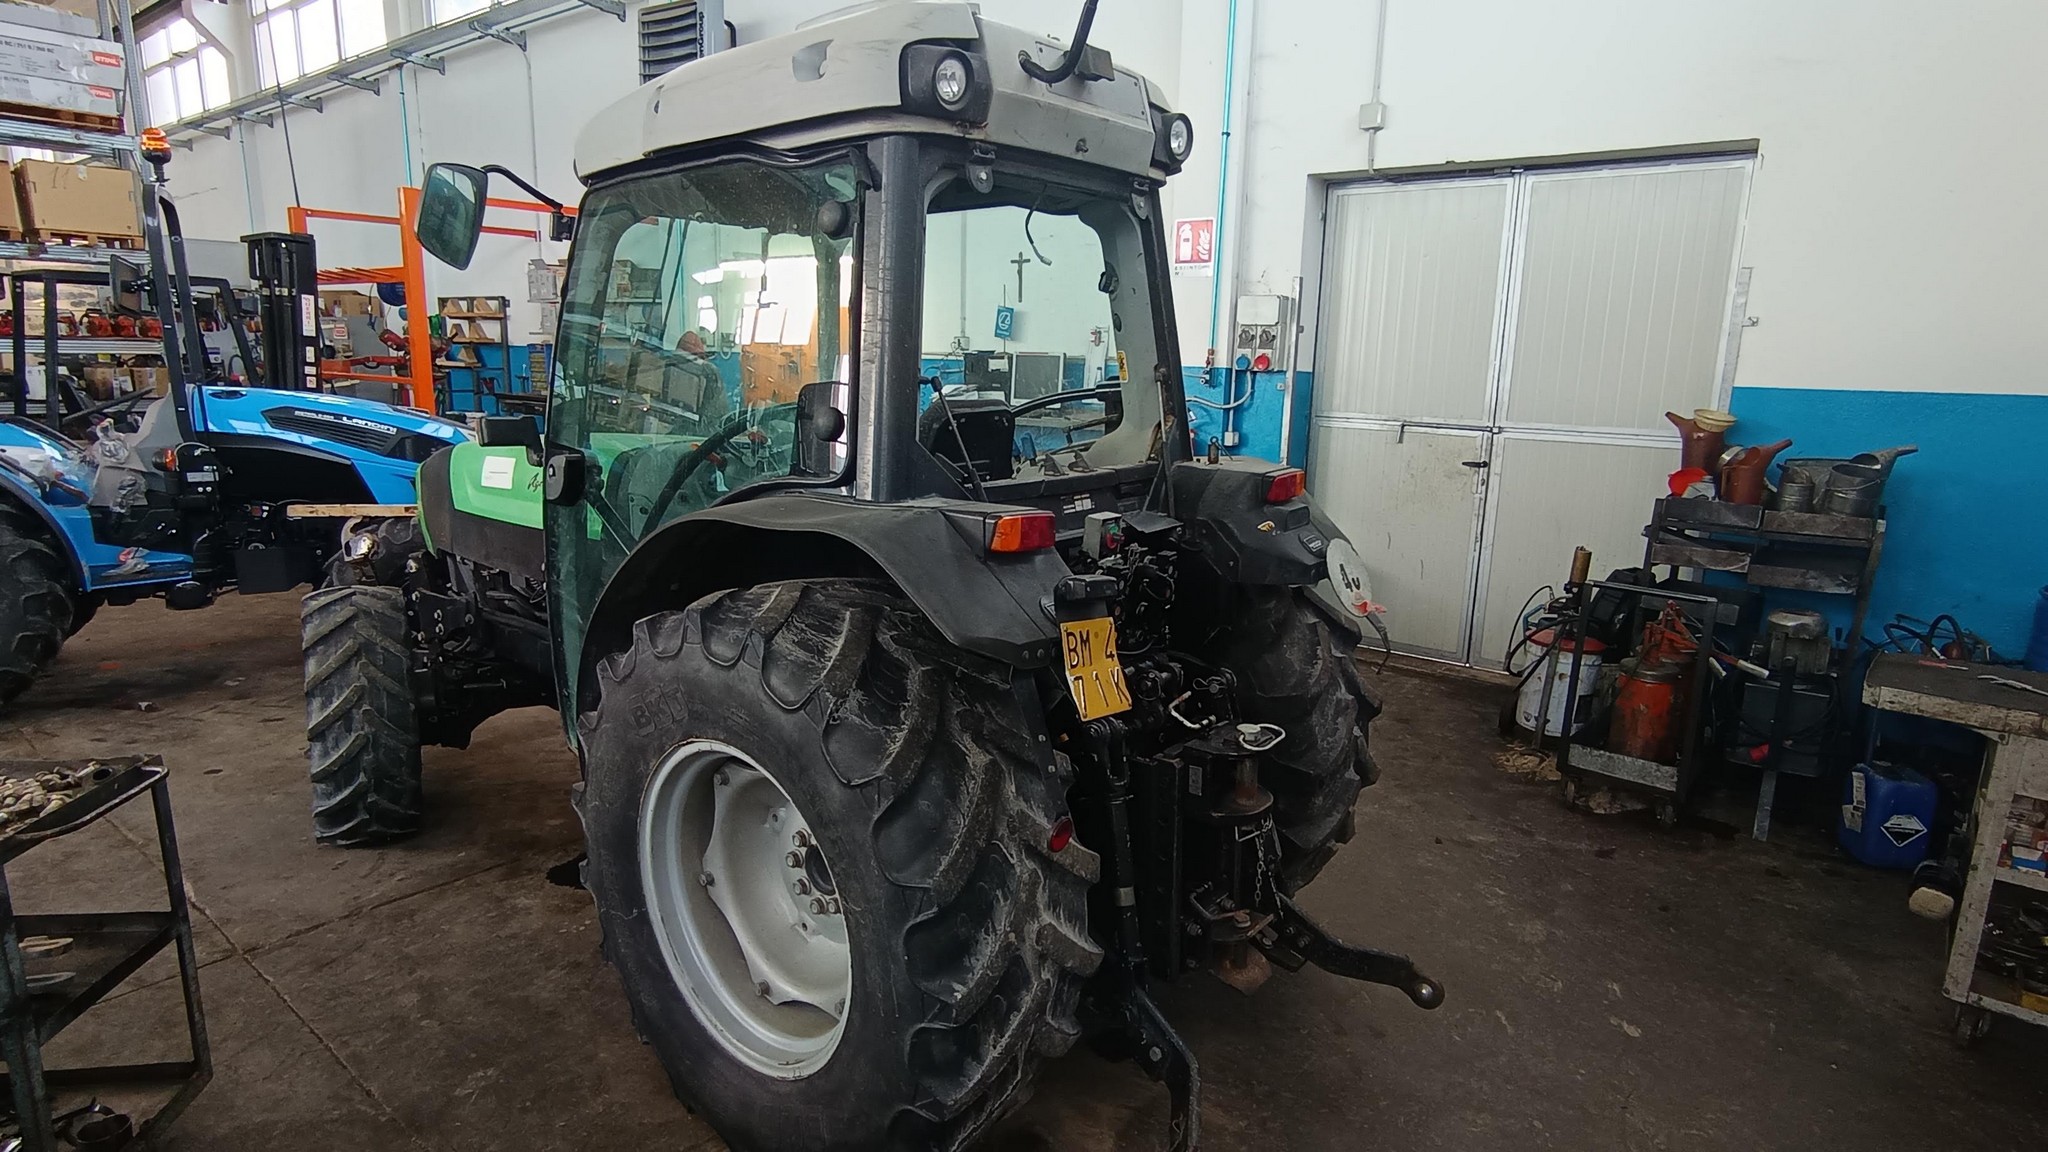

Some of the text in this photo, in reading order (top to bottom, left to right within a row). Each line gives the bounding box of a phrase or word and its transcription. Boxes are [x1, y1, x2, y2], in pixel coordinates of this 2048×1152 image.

[94, 55, 119, 66] STIHL
[1066, 622, 1116, 669] BM 4
